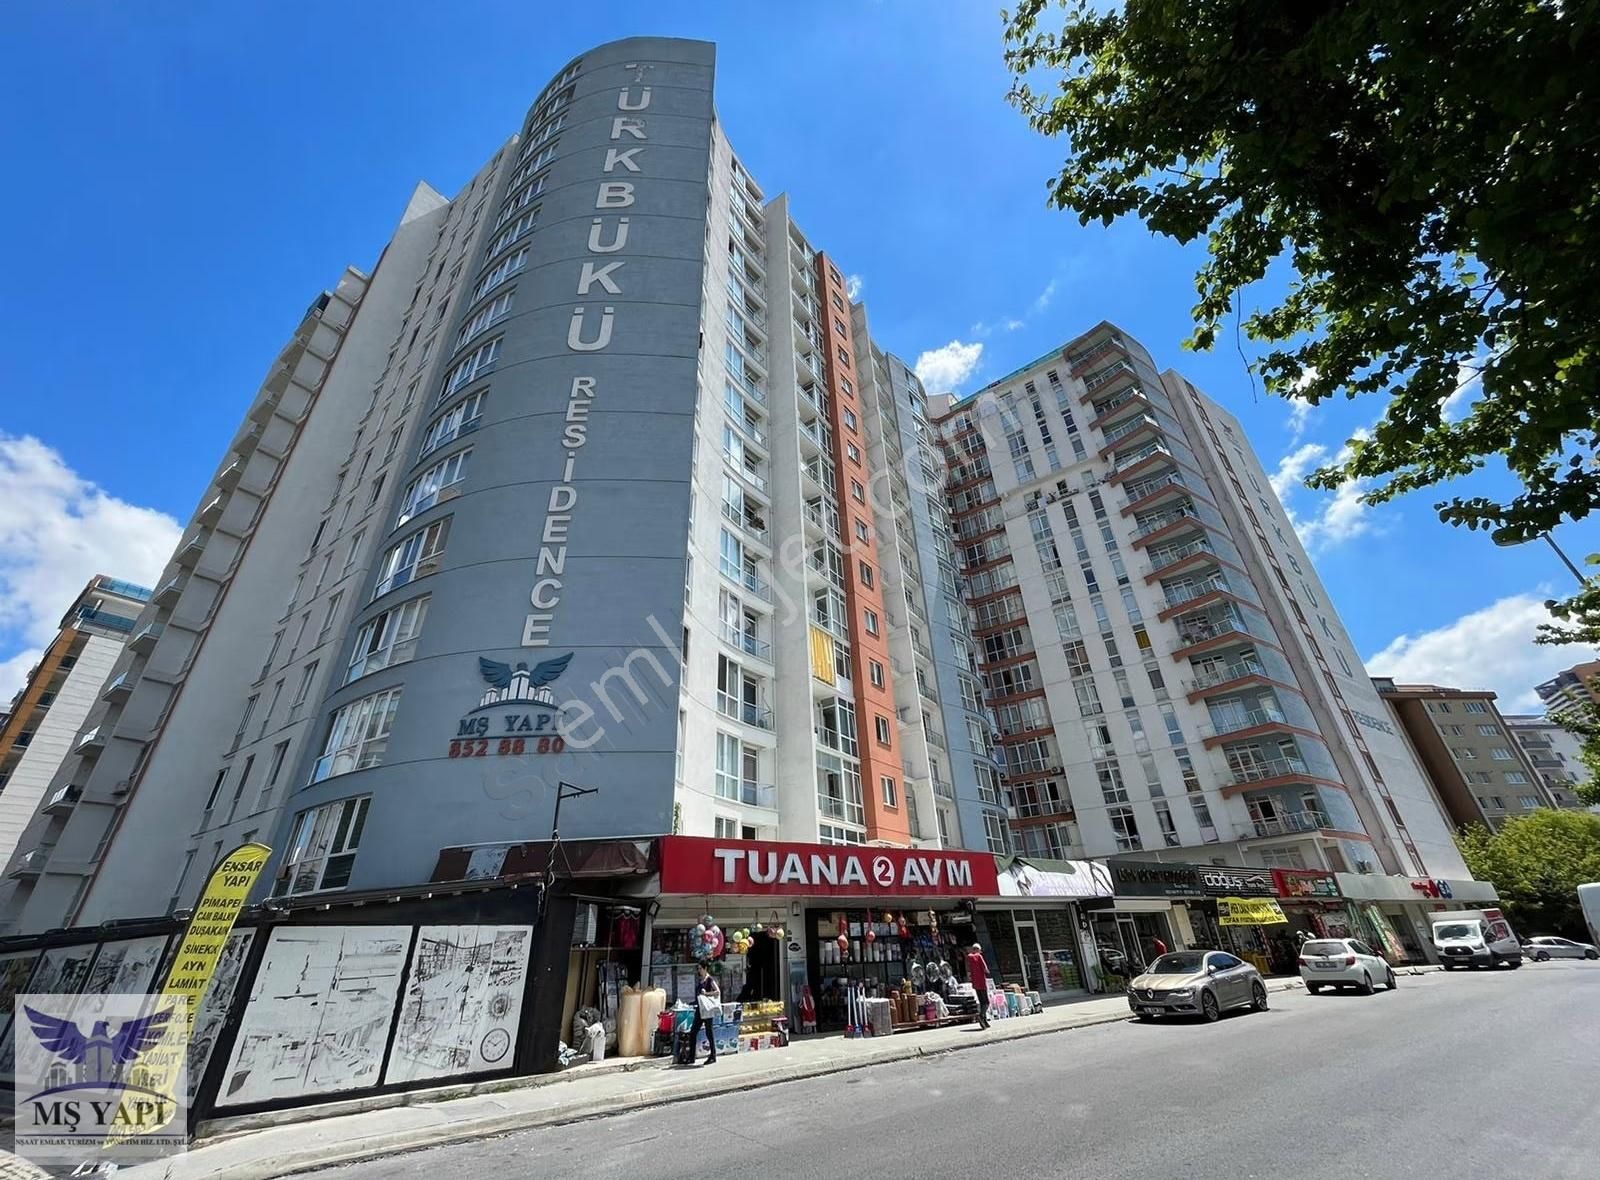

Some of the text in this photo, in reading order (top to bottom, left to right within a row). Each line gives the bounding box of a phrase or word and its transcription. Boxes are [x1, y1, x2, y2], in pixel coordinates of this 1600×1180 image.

[457, 717, 489, 737] MŞ
[222, 861, 262, 872] ENSAR
[714, 848, 973, 886] TUANA 2 AVM
[223, 876, 251, 887] YAPI
